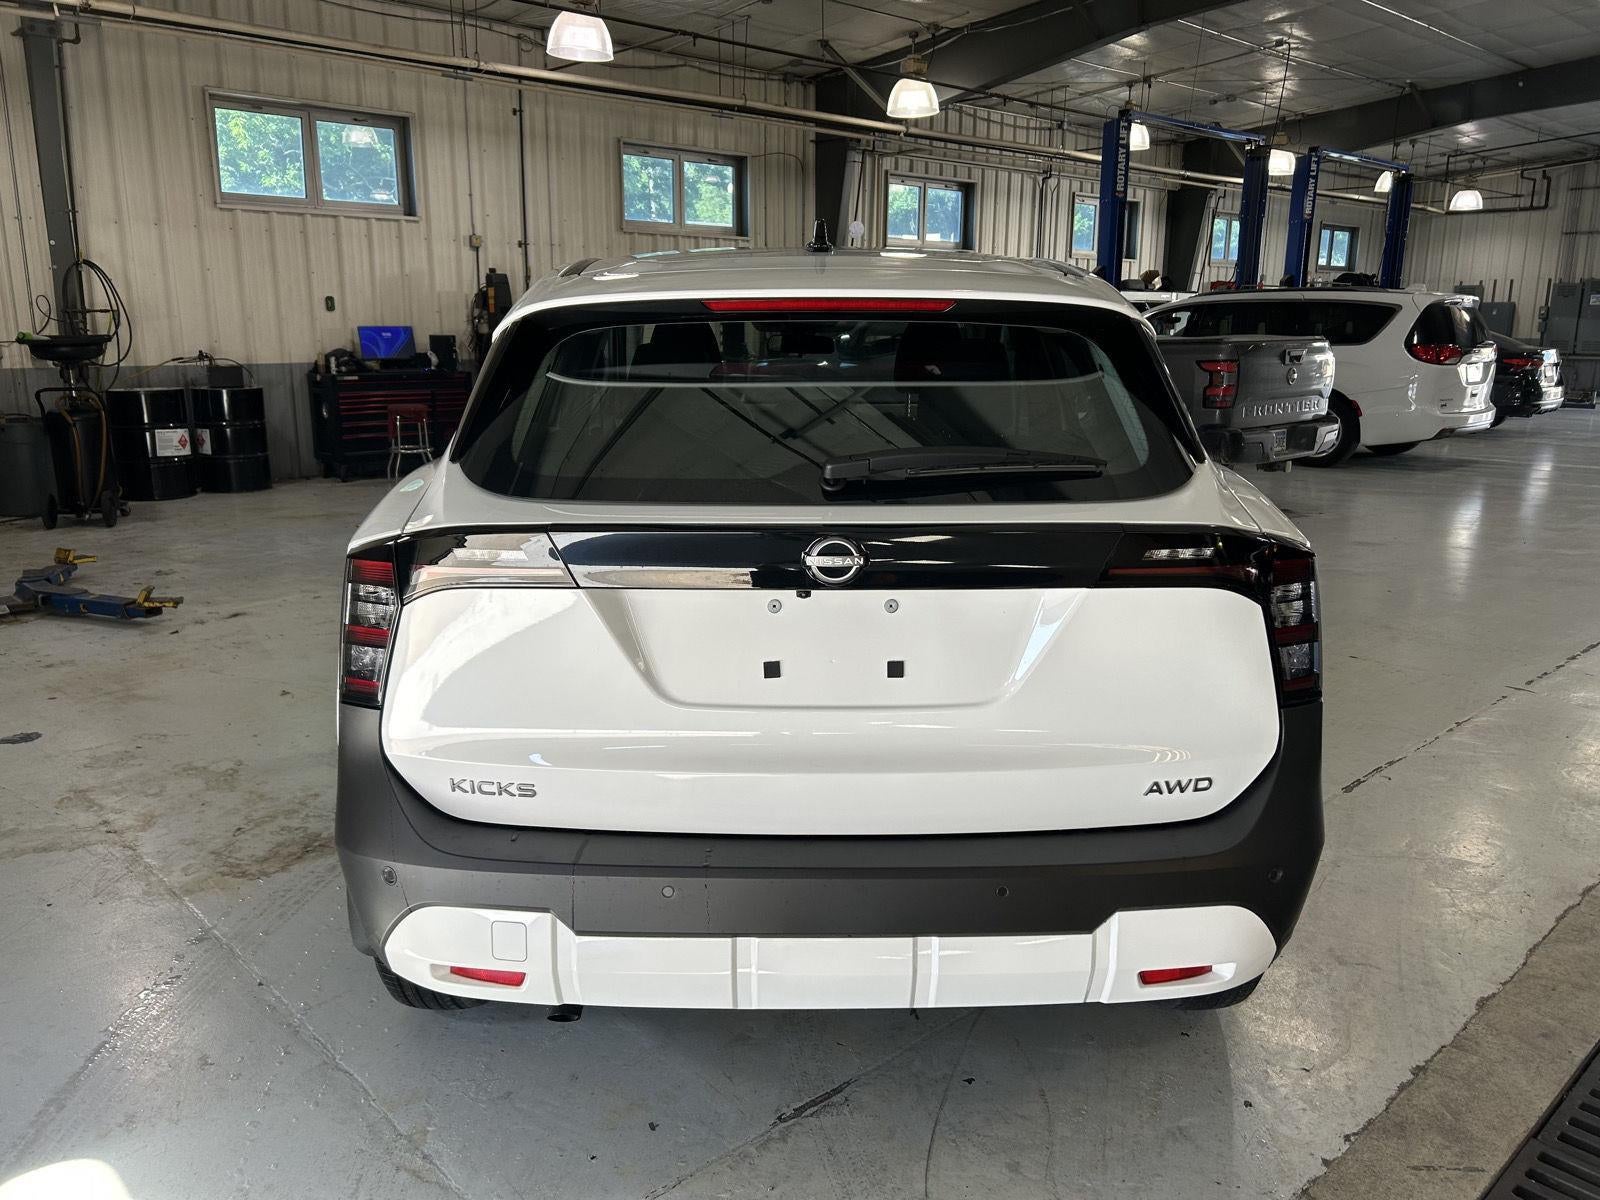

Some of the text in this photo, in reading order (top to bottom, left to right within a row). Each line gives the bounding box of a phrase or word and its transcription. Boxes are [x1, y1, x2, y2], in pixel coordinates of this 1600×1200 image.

[1116, 119, 1128, 191] ROTARY LIFT
[1305, 156, 1318, 214] ROTARY LIFT
[806, 557, 864, 566] NISSAN
[449, 778, 537, 798] KICKS
[1143, 777, 1213, 796] AWD
